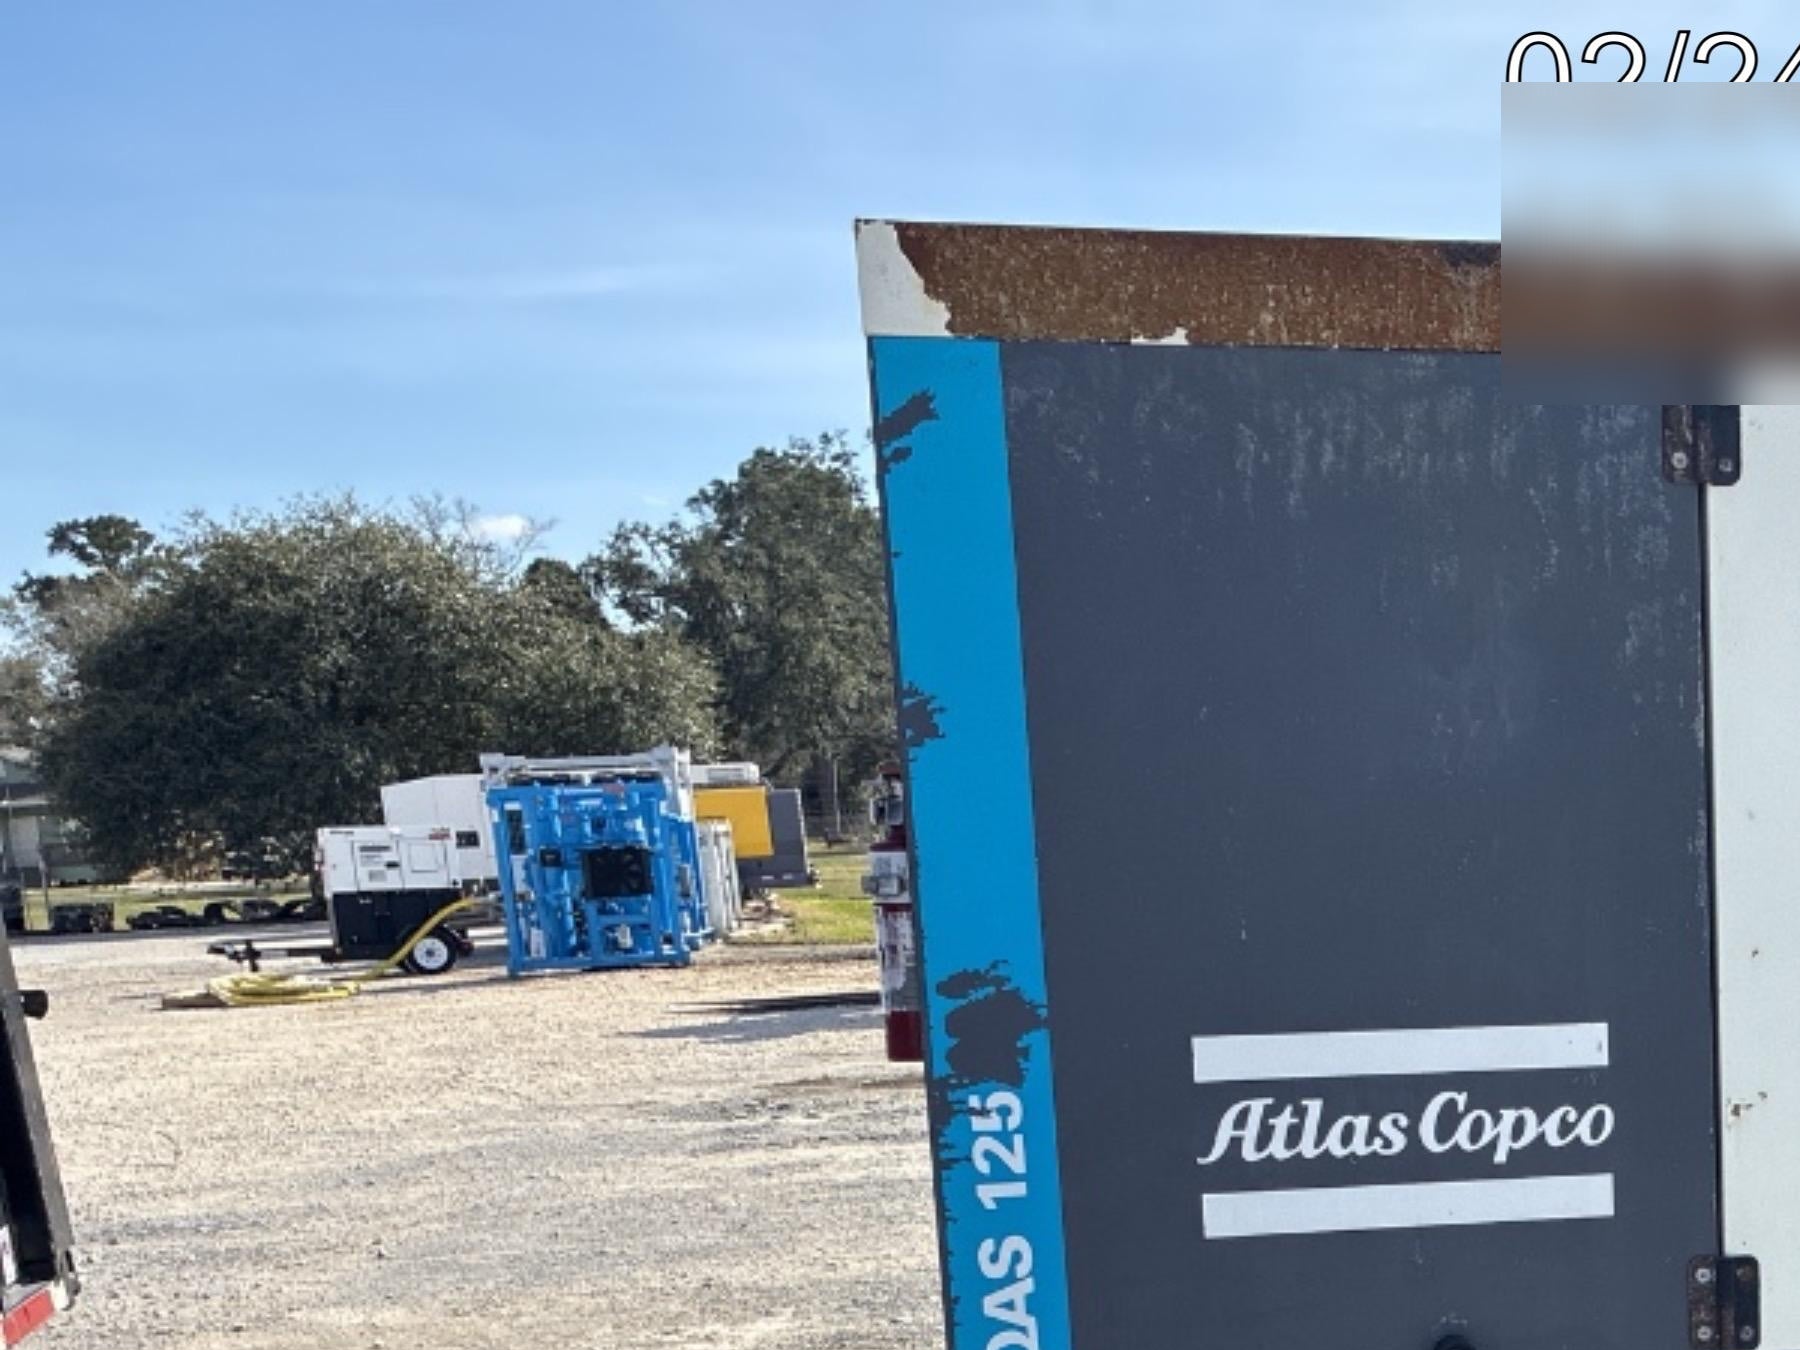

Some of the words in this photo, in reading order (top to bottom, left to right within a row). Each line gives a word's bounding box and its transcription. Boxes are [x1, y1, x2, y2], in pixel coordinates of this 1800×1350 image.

[968, 1090, 1028, 1210] 125
[1196, 1097, 1409, 1165] Atlas
[1418, 1091, 1615, 1164] Copco
